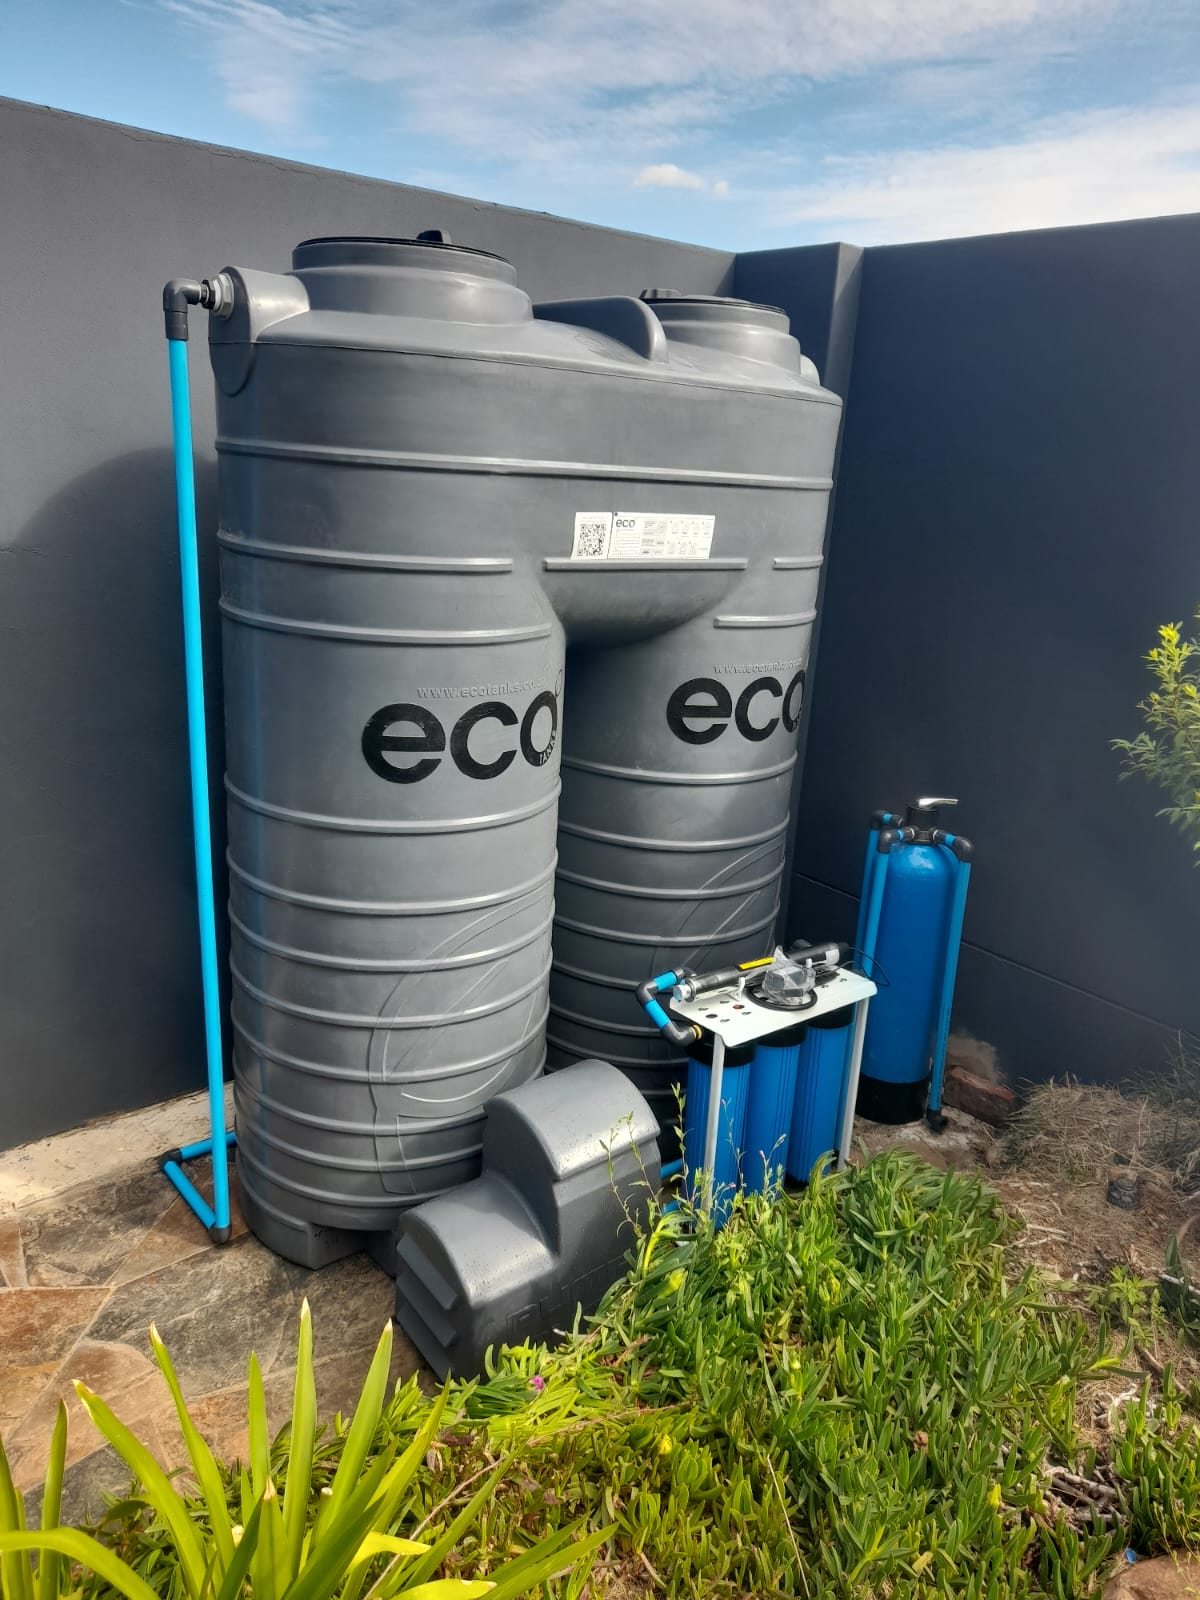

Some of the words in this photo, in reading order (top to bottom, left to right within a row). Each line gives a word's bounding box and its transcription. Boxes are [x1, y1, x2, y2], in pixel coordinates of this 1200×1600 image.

[615, 518, 636, 528] eco
[361, 690, 558, 784] eco
[666, 669, 806, 745] eco
